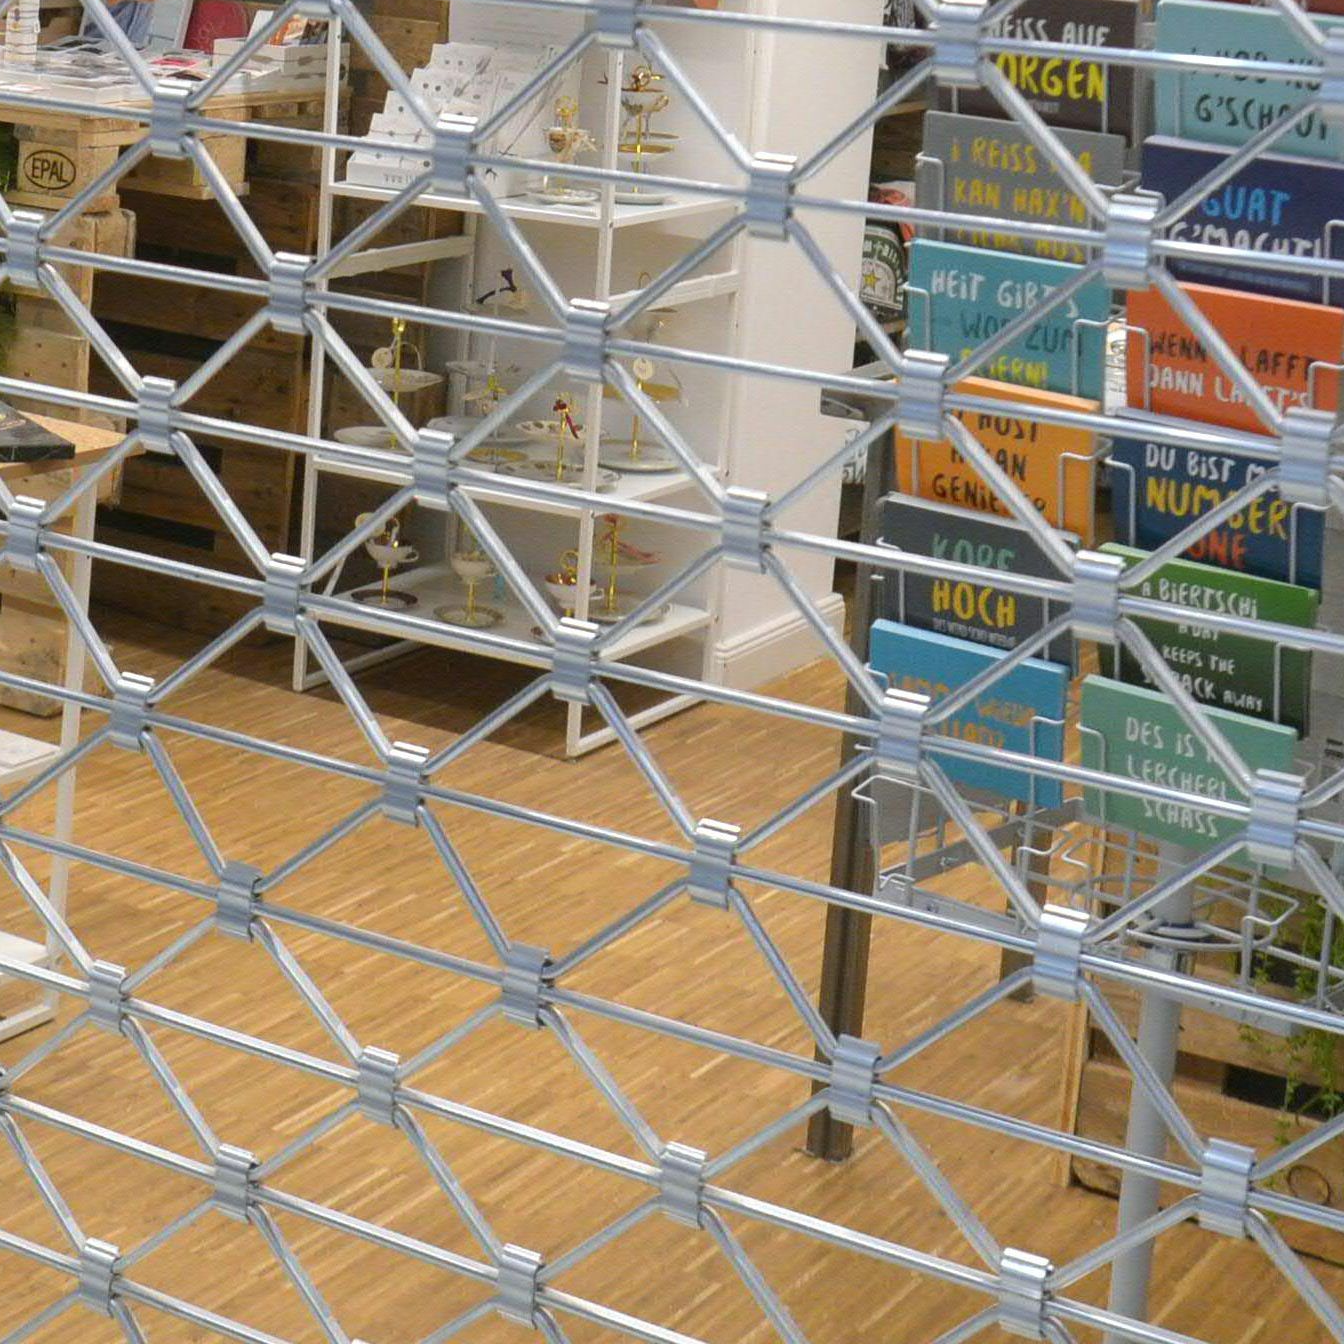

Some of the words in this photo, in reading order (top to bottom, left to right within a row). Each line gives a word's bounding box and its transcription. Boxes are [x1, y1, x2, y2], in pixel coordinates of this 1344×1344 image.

[994, 51, 1105, 102] ORGEN
[32, 157, 69, 183] EPAL
[1145, 443, 1176, 472] DU
[931, 576, 1017, 629] HOCH
[1210, 653, 1236, 675] THE
[1125, 716, 1164, 750] DES
